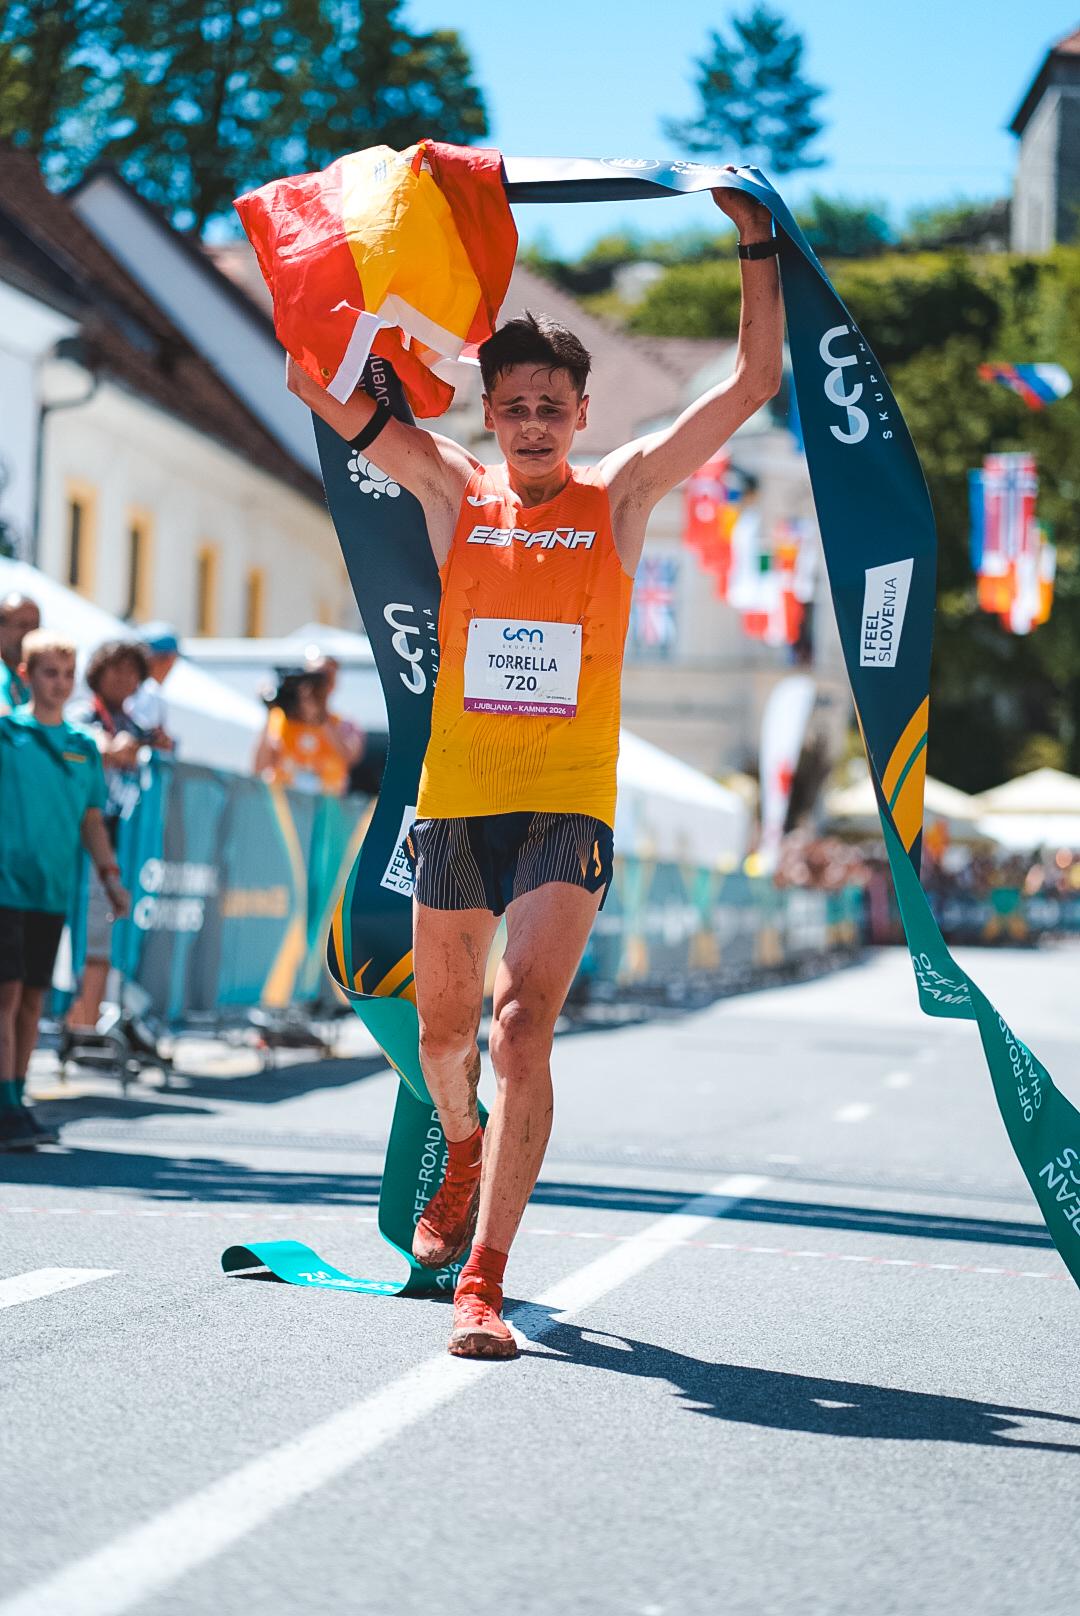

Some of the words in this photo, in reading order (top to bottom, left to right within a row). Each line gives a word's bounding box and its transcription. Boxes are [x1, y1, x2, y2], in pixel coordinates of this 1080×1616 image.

[466, 525, 597, 549] ESPAÑA
[864, 610, 880, 651] FEEL
[878, 577, 898, 662] SLOVENIA
[422, 608, 440, 701] KUPINA
[488, 654, 558, 672] TORRELLA
[504, 674, 537, 691] 720
[474, 702, 513, 712] LJUBLJANA
[518, 705, 548, 713] KAMNIK
[549, 706, 567, 715] 2026
[390, 845, 407, 876] FEE
